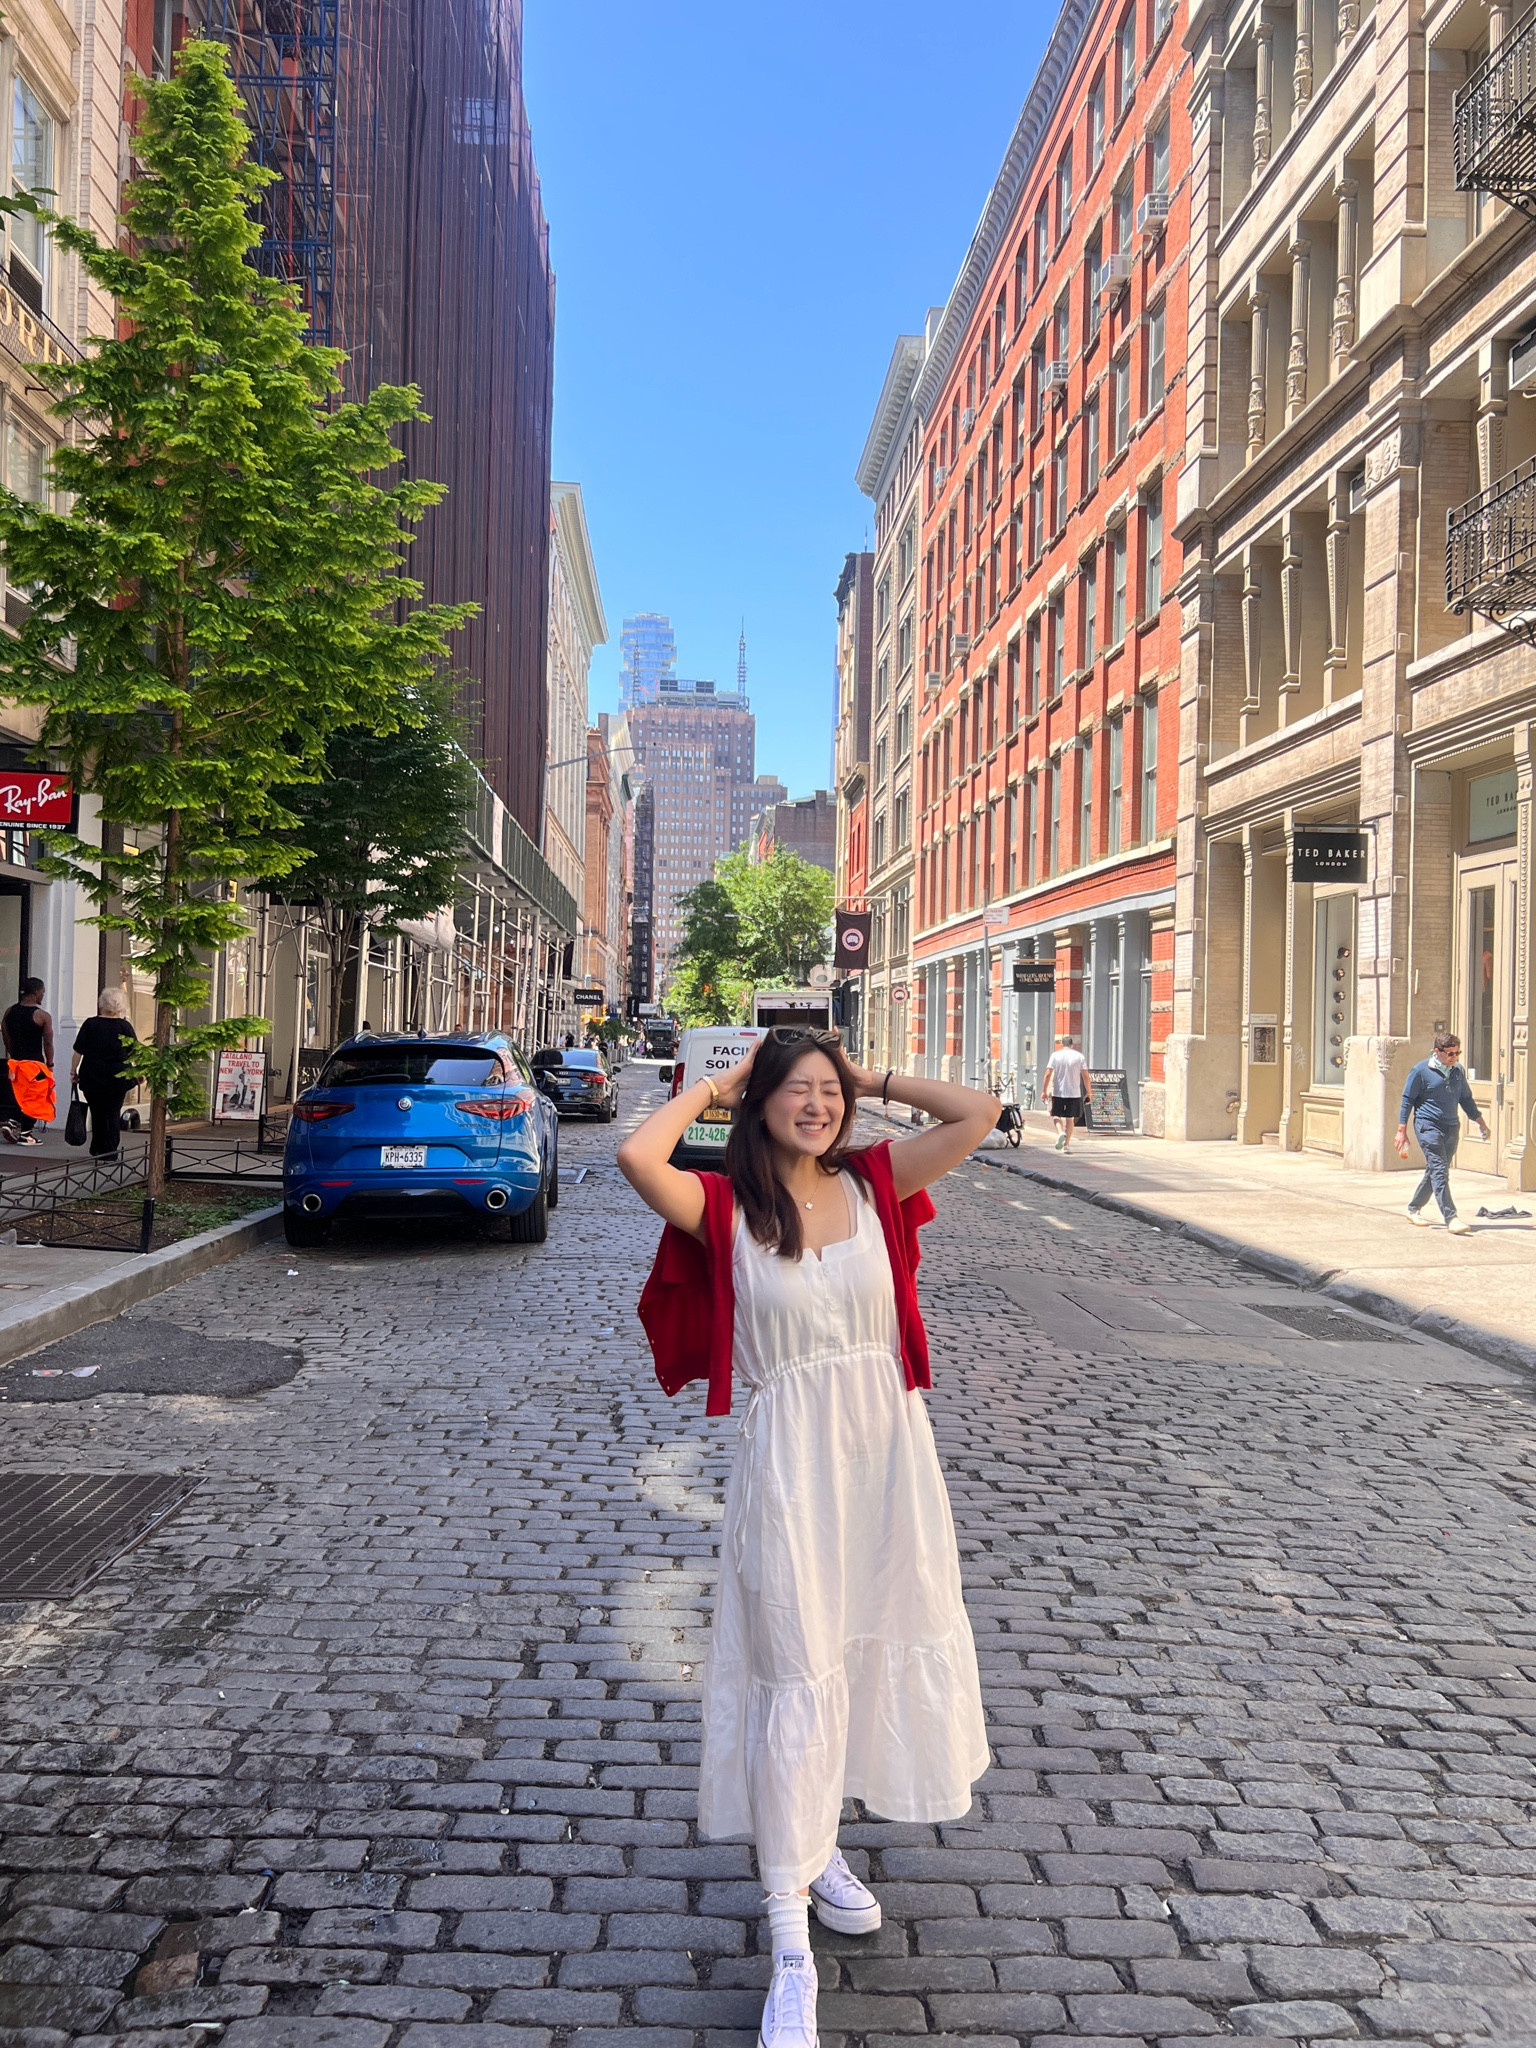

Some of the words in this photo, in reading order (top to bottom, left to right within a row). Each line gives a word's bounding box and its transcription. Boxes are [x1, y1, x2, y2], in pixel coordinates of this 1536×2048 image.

[0, 778, 67, 815] Ray-Ban
[1297, 848, 1319, 858] TED
[1328, 848, 1366, 858] BAKER
[228, 1060, 251, 1068] TRAVEL
[219, 1067, 234, 1075] NEW
[247, 1068, 265, 1076] YORK
